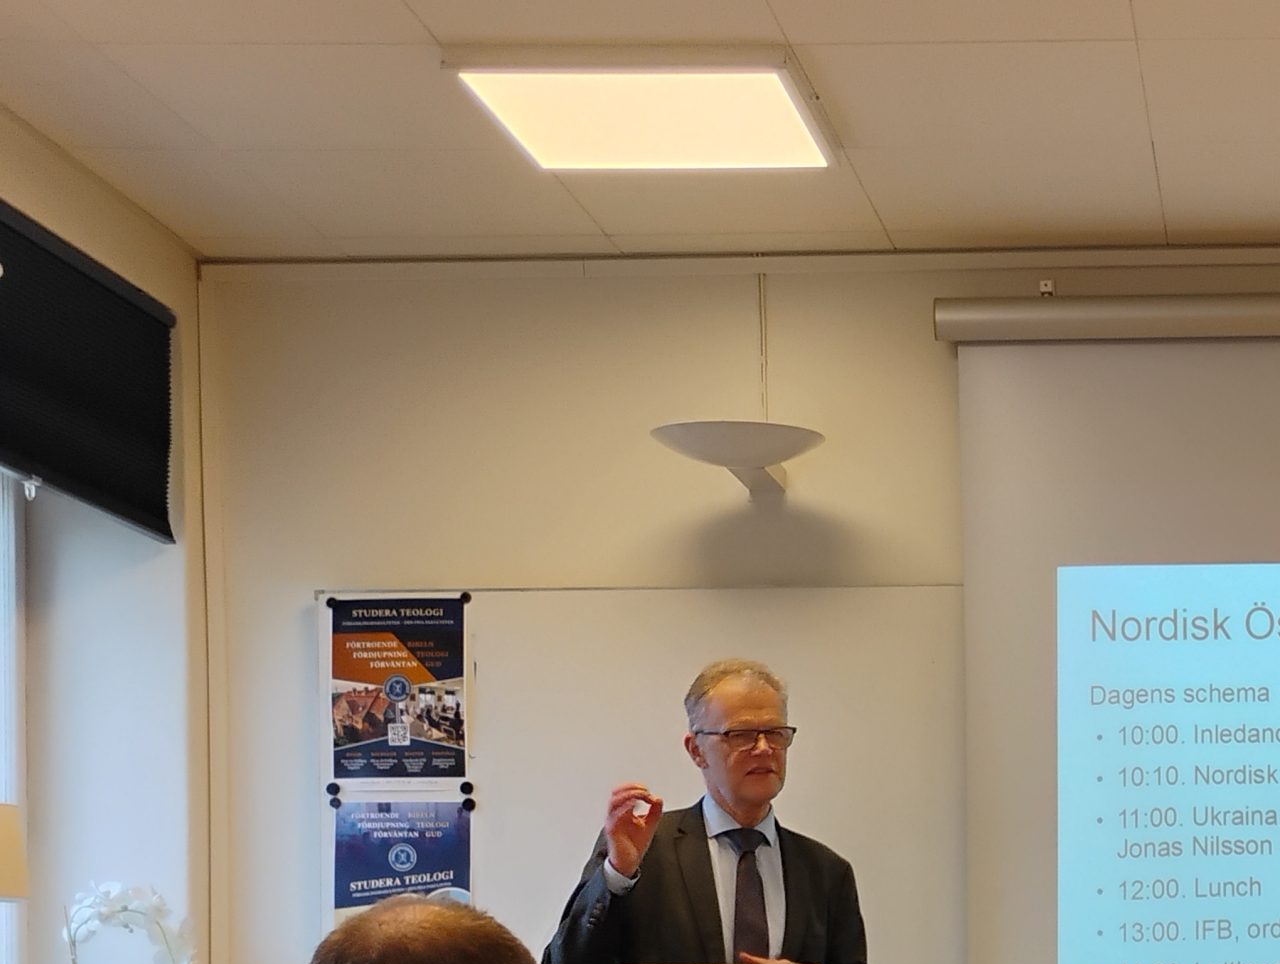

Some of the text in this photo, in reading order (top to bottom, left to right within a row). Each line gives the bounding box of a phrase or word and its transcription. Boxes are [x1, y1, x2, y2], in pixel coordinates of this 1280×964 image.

[352, 607, 444, 618] STUDERA TEOLOGI
[1091, 608, 1232, 642] Nordisk
[1091, 683, 1269, 707] Dagens schema
[1119, 724, 1184, 746] 10:00.
[1119, 766, 1185, 787] 10:10.
[1195, 764, 1278, 785] Nordisk
[1119, 807, 1183, 829] 11:00.
[1117, 836, 1272, 858] Jonas Nilsson
[350, 876, 401, 892] STUDERA
[404, 870, 454, 886] TEOLOGI
[1119, 877, 1261, 900] 12:00. Lunch
[1120, 921, 1185, 942] 13:00.
[1196, 919, 1238, 942] IFB,
